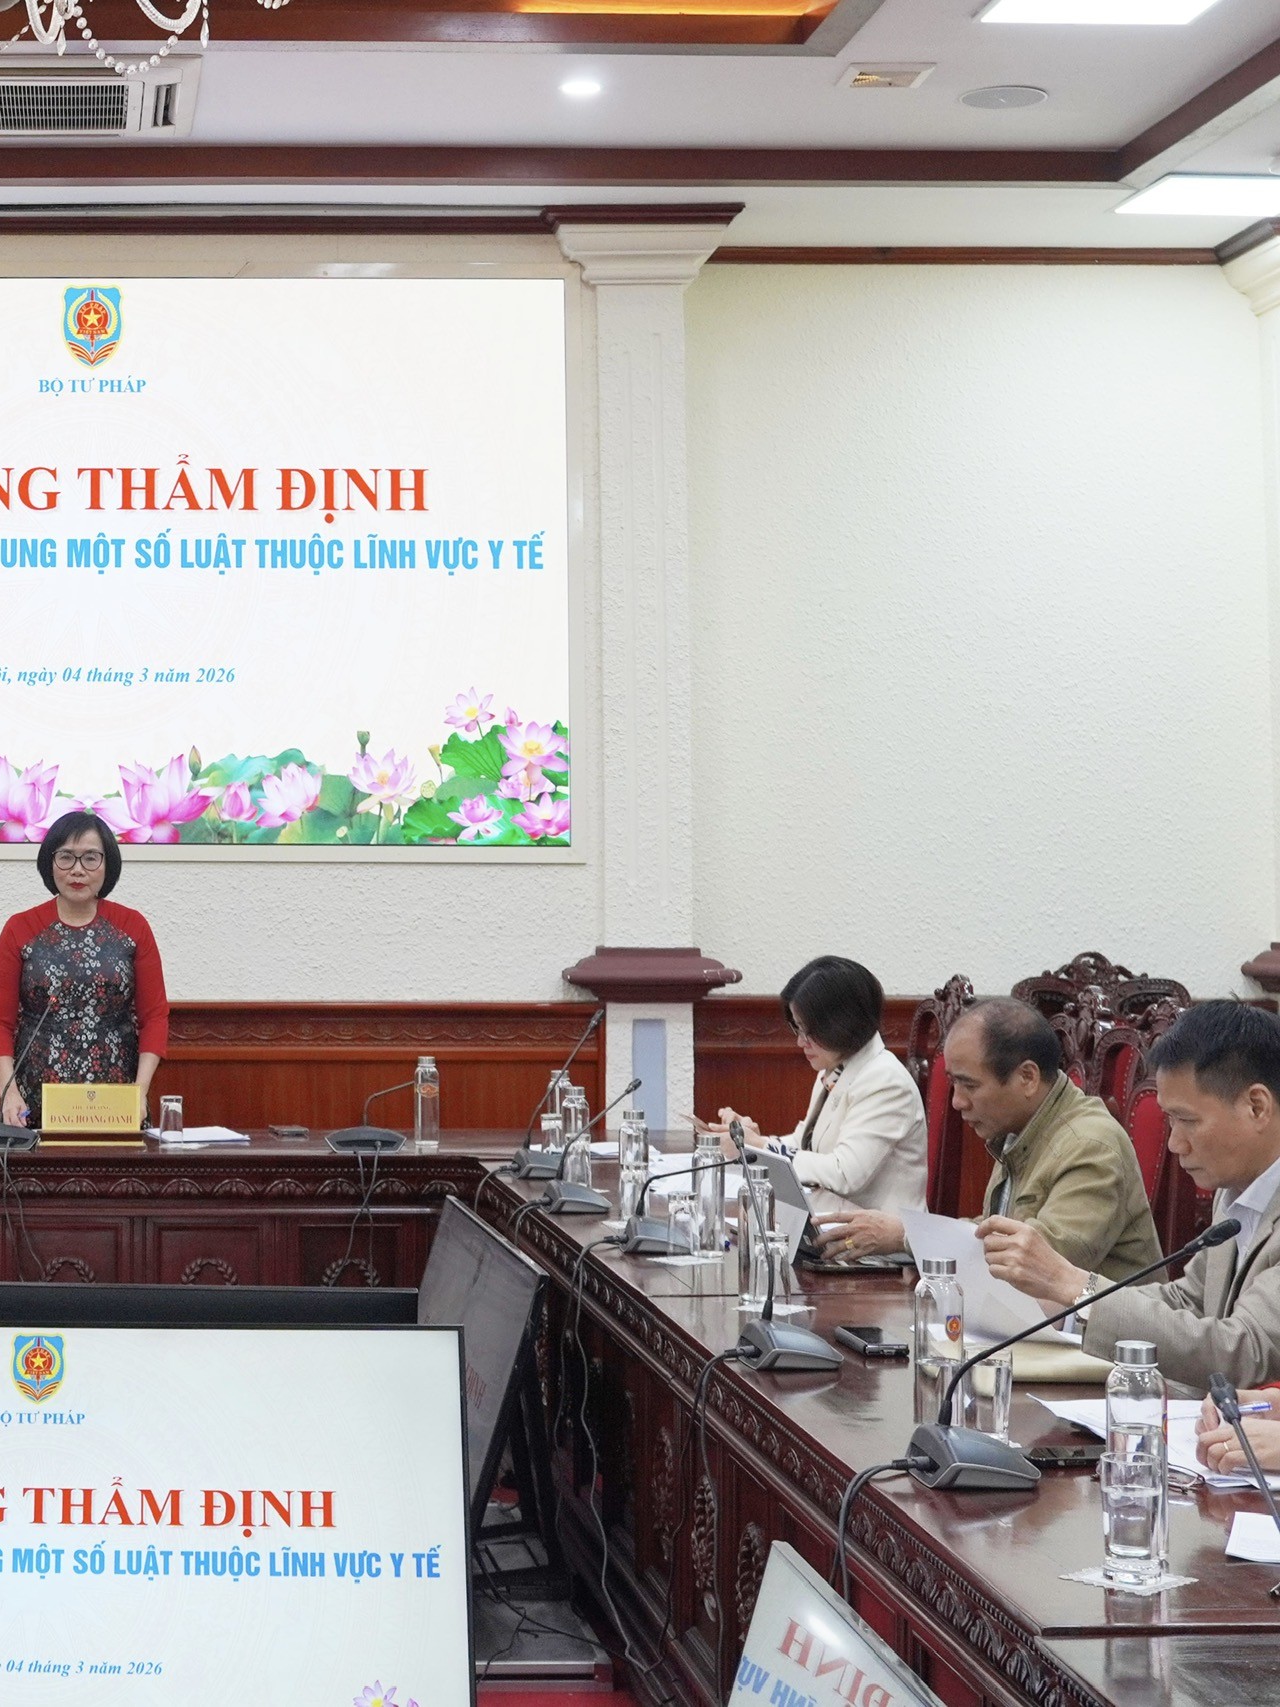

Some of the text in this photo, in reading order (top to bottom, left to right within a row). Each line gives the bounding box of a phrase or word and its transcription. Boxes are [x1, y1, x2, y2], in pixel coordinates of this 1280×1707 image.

[38, 374, 147, 397] BỘ TƯ PHÁP
[77, 453, 258, 511] THẨM
[276, 467, 429, 524] ĐỊNH
[67, 533, 125, 574] MỘT
[135, 529, 171, 568] SỐ
[181, 533, 246, 575] LUẬT
[255, 533, 343, 575] THUỘC
[354, 534, 415, 569] LĨNH
[425, 536, 478, 576] VỰC
[488, 540, 504, 569] Y
[513, 531, 545, 569] TẾ
[18, 668, 58, 687] ngày
[62, 667, 83, 682] 04
[87, 667, 135, 687] tháng
[139, 668, 149, 682] 3
[154, 668, 191, 682] năm
[196, 667, 236, 682] 2026
[16, 1411, 40, 1424] TƯ
[43, 1409, 86, 1425] PHÁP
[23, 1476, 184, 1526] THẨM
[200, 1490, 336, 1538] ĐỊNH
[12, 1543, 64, 1579] MỘT
[73, 1540, 106, 1575] SỐ
[114, 1545, 173, 1580] LUẬT
[181, 1546, 261, 1582] THUỘC
[269, 1547, 325, 1577] LĨNH
[334, 1551, 382, 1583] VỰC
[390, 1552, 404, 1577] Y
[412, 1544, 442, 1578] TẾ
[6, 1660, 23, 1673] 04
[28, 1660, 71, 1678] tháng
[76, 1661, 85, 1674] 3
[89, 1662, 122, 1675] năm
[127, 1662, 163, 1675] 2026
